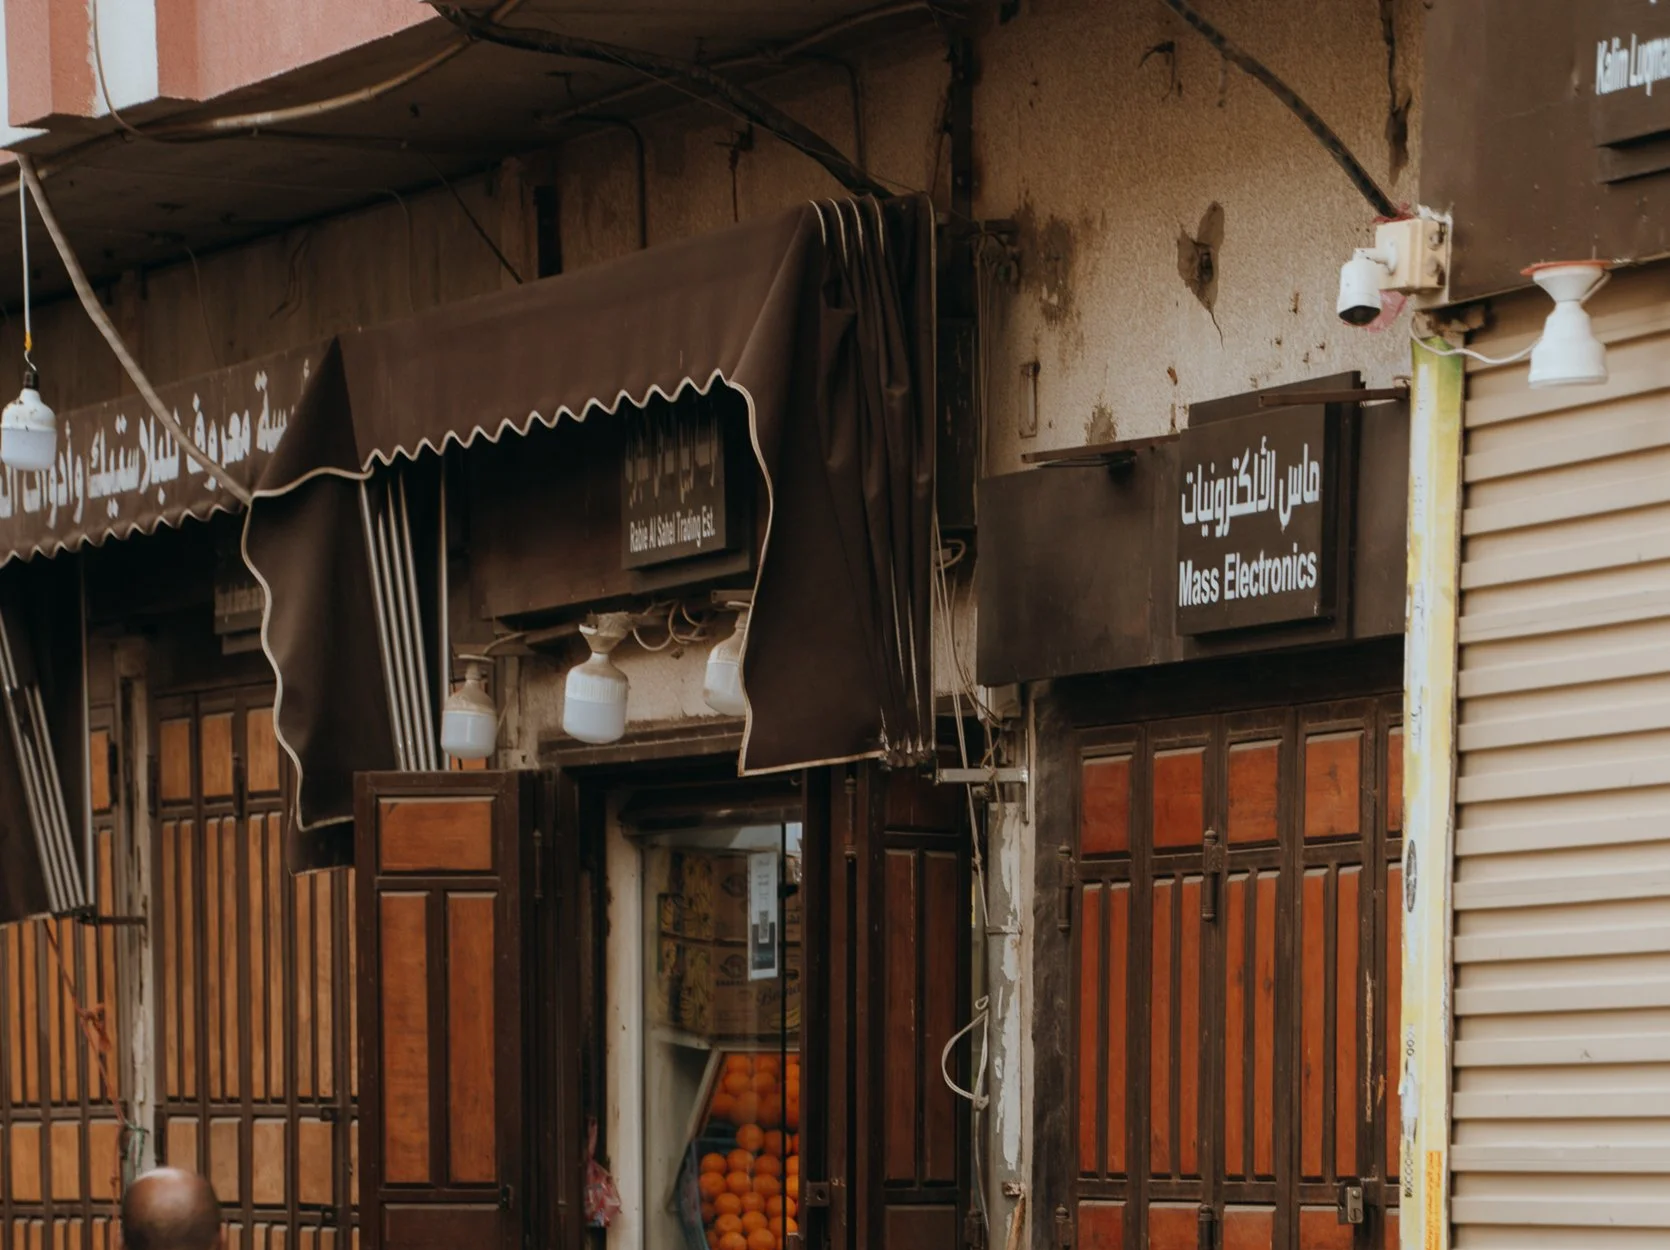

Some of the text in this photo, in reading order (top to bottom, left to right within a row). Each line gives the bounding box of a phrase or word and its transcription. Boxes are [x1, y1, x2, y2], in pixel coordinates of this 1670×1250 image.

[1279, 443, 1320, 527] ماس
[649, 516, 656, 549] Al
[676, 508, 701, 548] Trading
[1179, 542, 1317, 607] Mass Electronics
